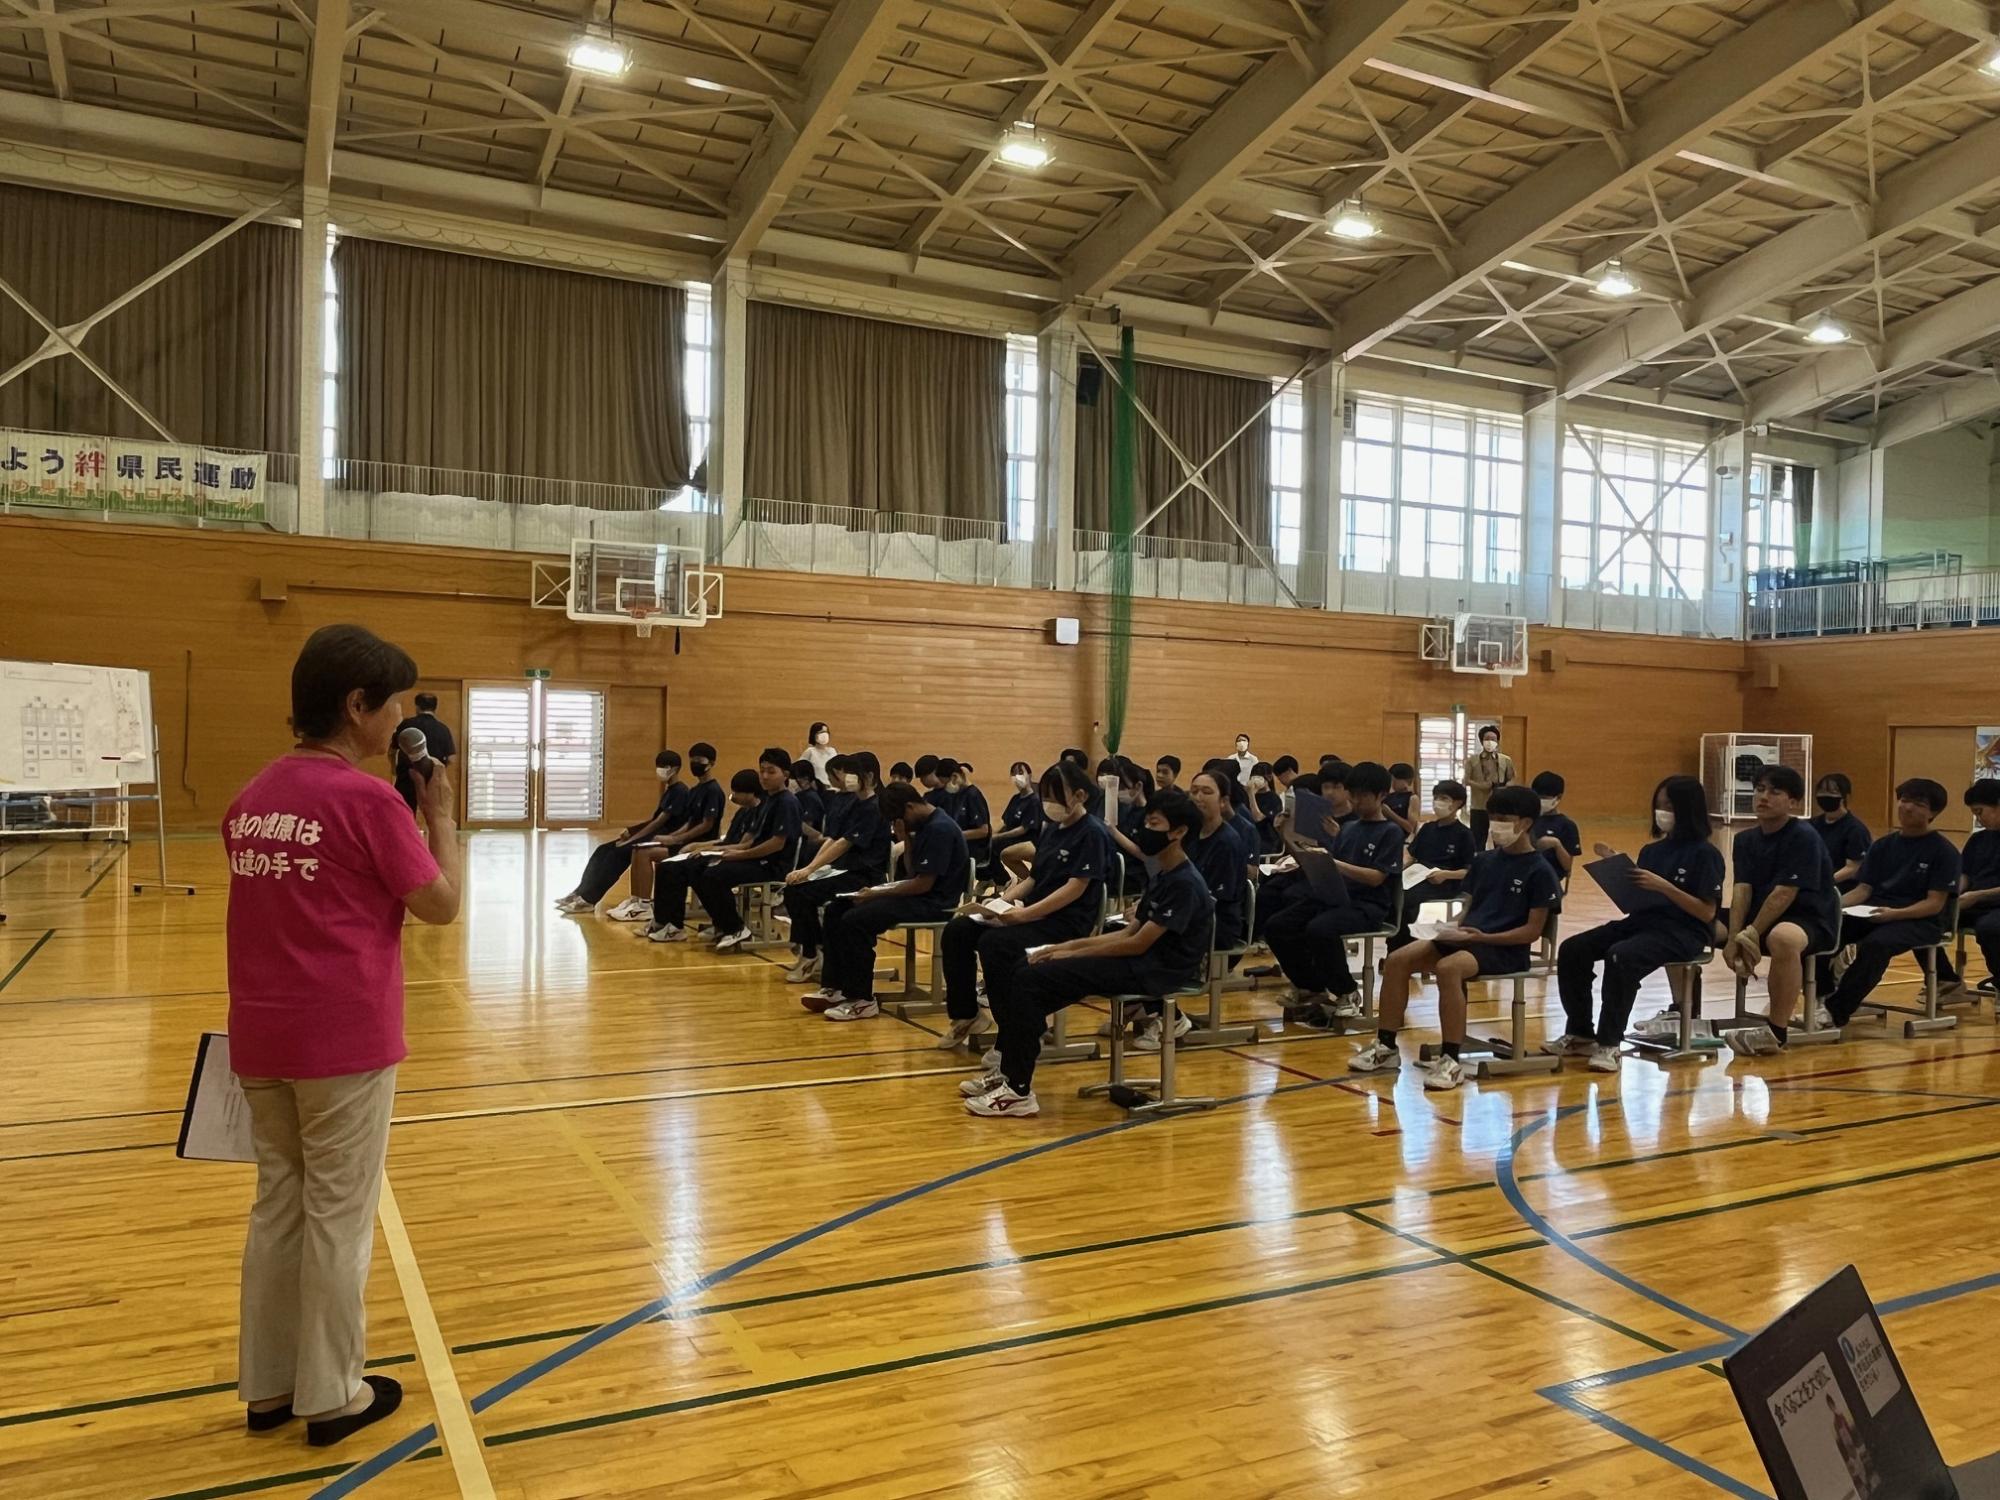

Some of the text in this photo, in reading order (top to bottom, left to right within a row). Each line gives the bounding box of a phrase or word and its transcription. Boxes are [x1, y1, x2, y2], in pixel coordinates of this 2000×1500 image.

[1, 447, 256, 490] よう絆県民運動
